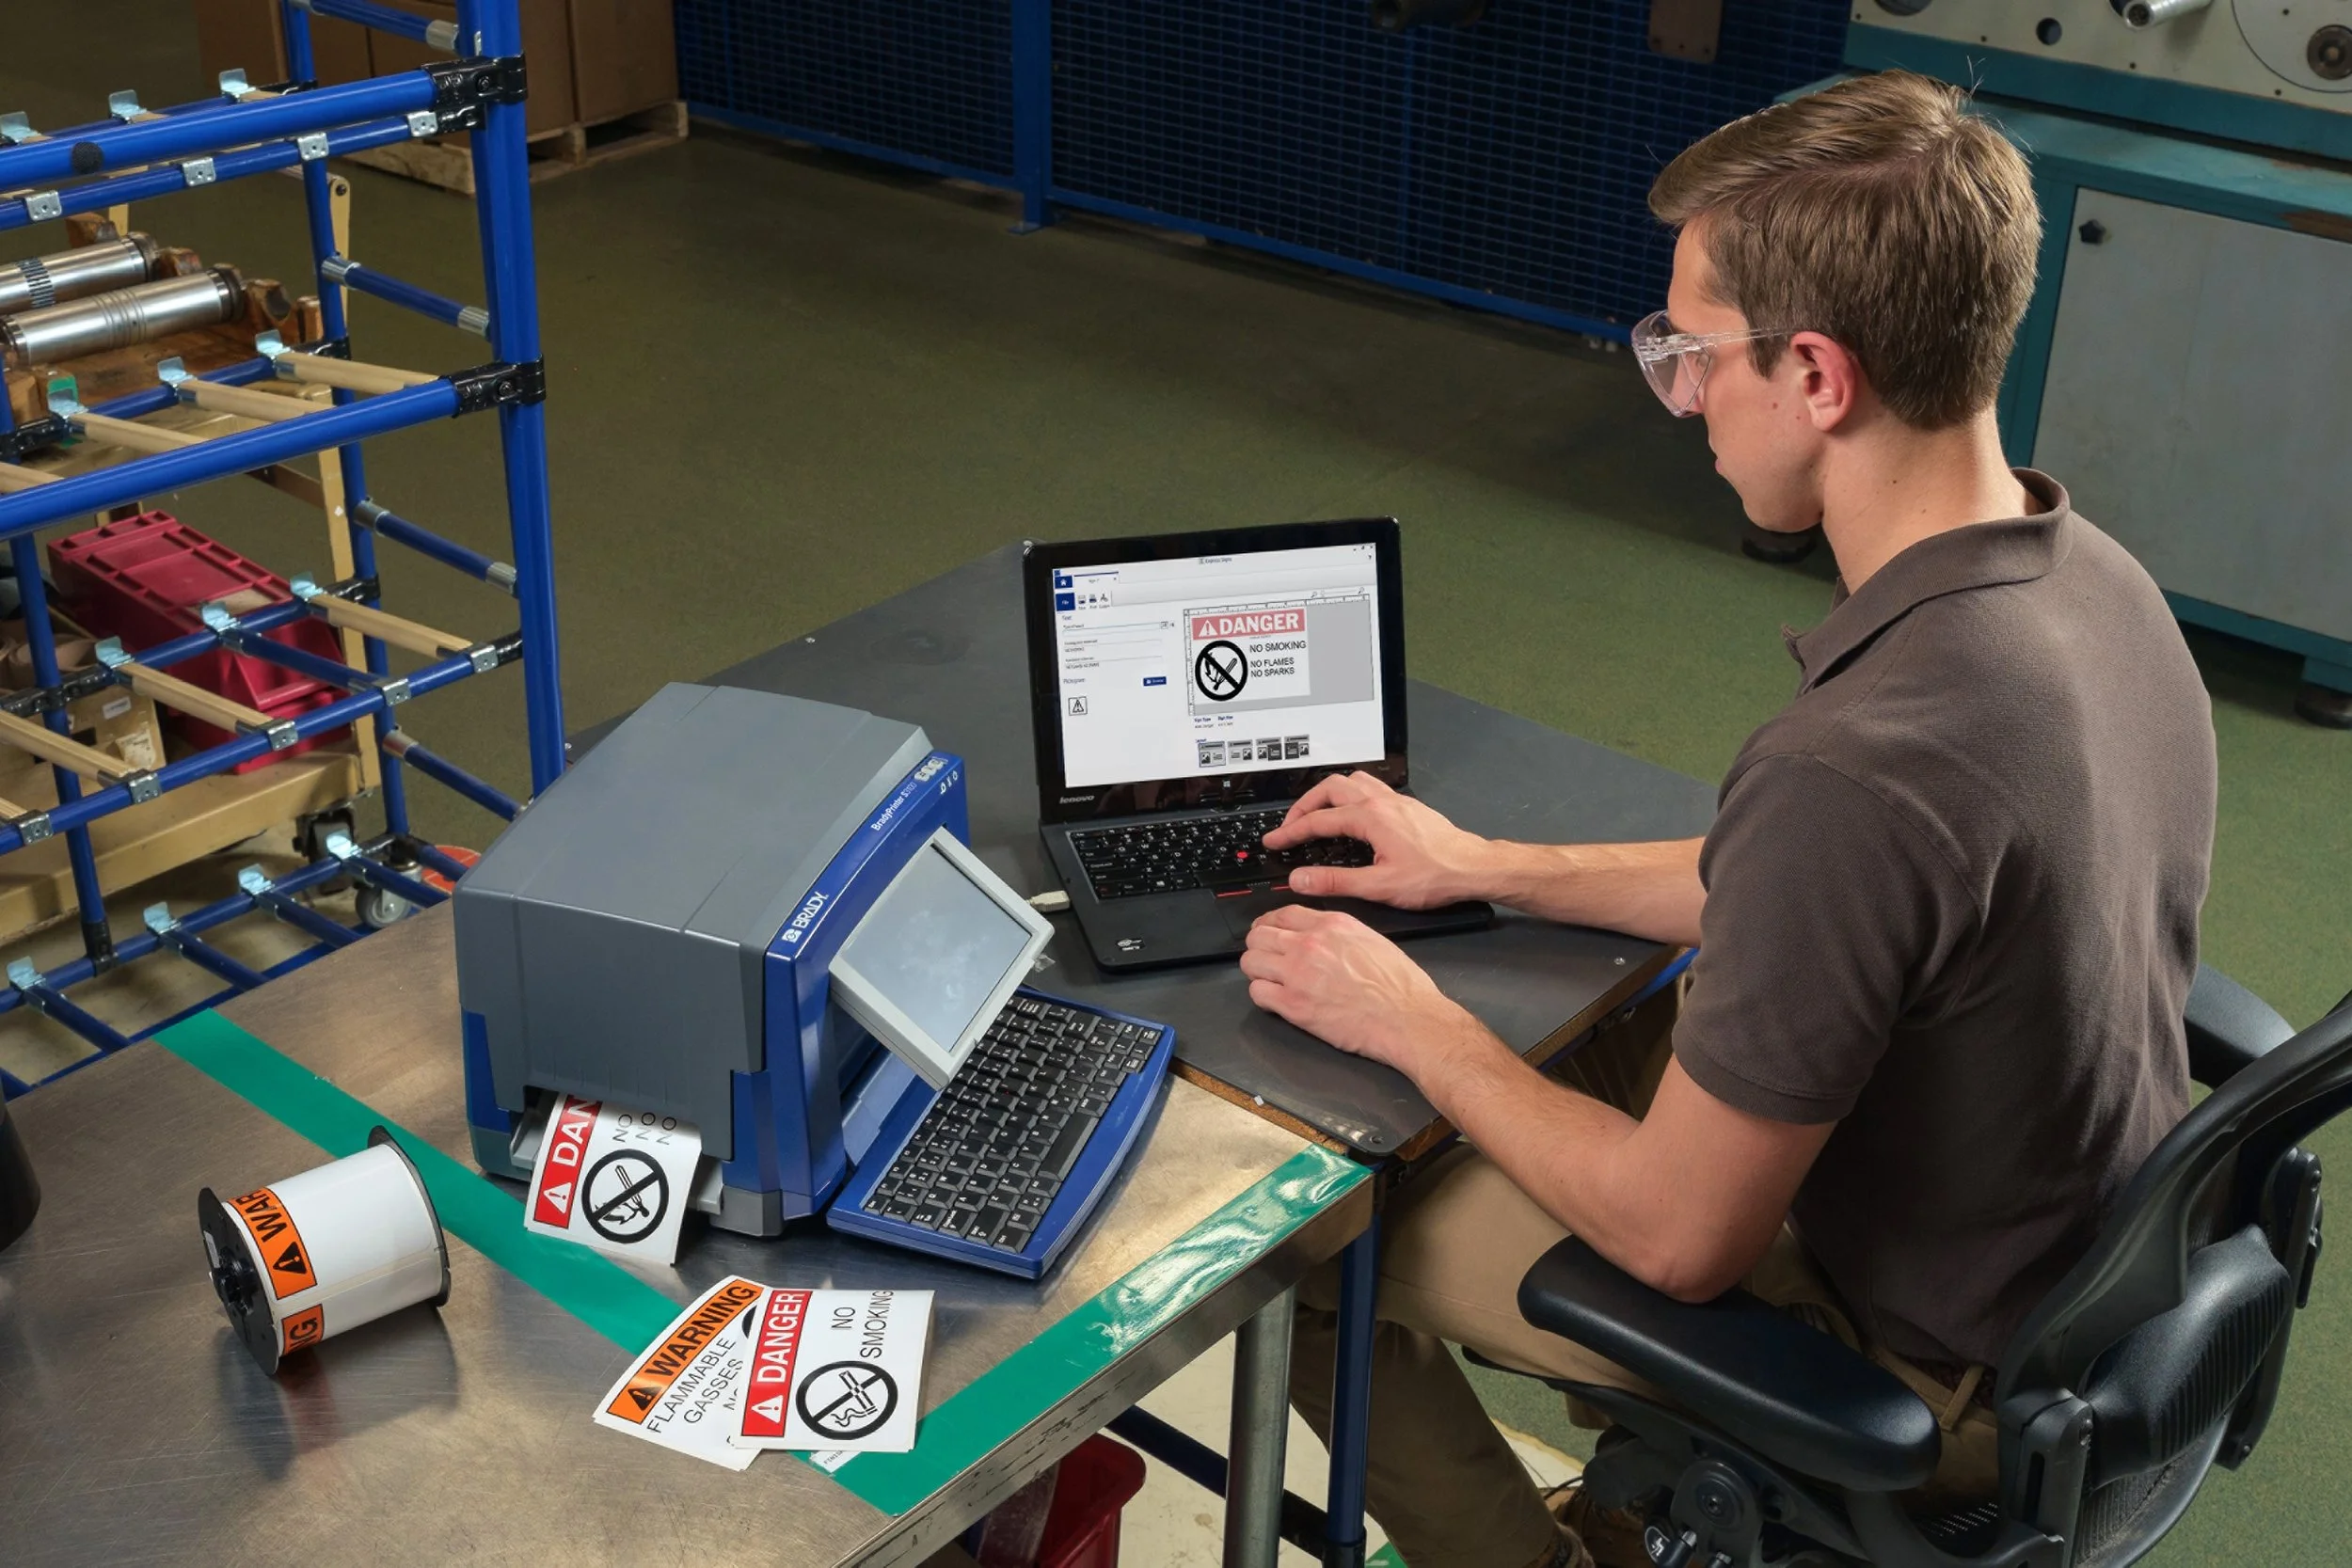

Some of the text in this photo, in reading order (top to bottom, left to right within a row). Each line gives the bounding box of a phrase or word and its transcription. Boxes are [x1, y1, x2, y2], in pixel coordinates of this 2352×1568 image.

[1219, 612, 1299, 636] DANGER
[1249, 641, 1307, 653] NO SMOKING
[1250, 657, 1295, 668] NO FLAMES
[1250, 667, 1295, 678] NO SPARKS
[871, 795, 904, 832] BradyPrinter
[1059, 795, 1095, 804] lenovo
[791, 891, 828, 929] BRADY
[612, 1114, 632, 1143] NO
[635, 1112, 656, 1141] NO
[656, 1117, 677, 1145] NO
[644, 1284, 756, 1378] WARNING
[831, 1307, 856, 1330] NO
[860, 1290, 894, 1359] SMOKING
[756, 1292, 806, 1384] DANGER
[646, 1337, 736, 1433] FLAMMABLE
[683, 1357, 744, 1424] GASSES
